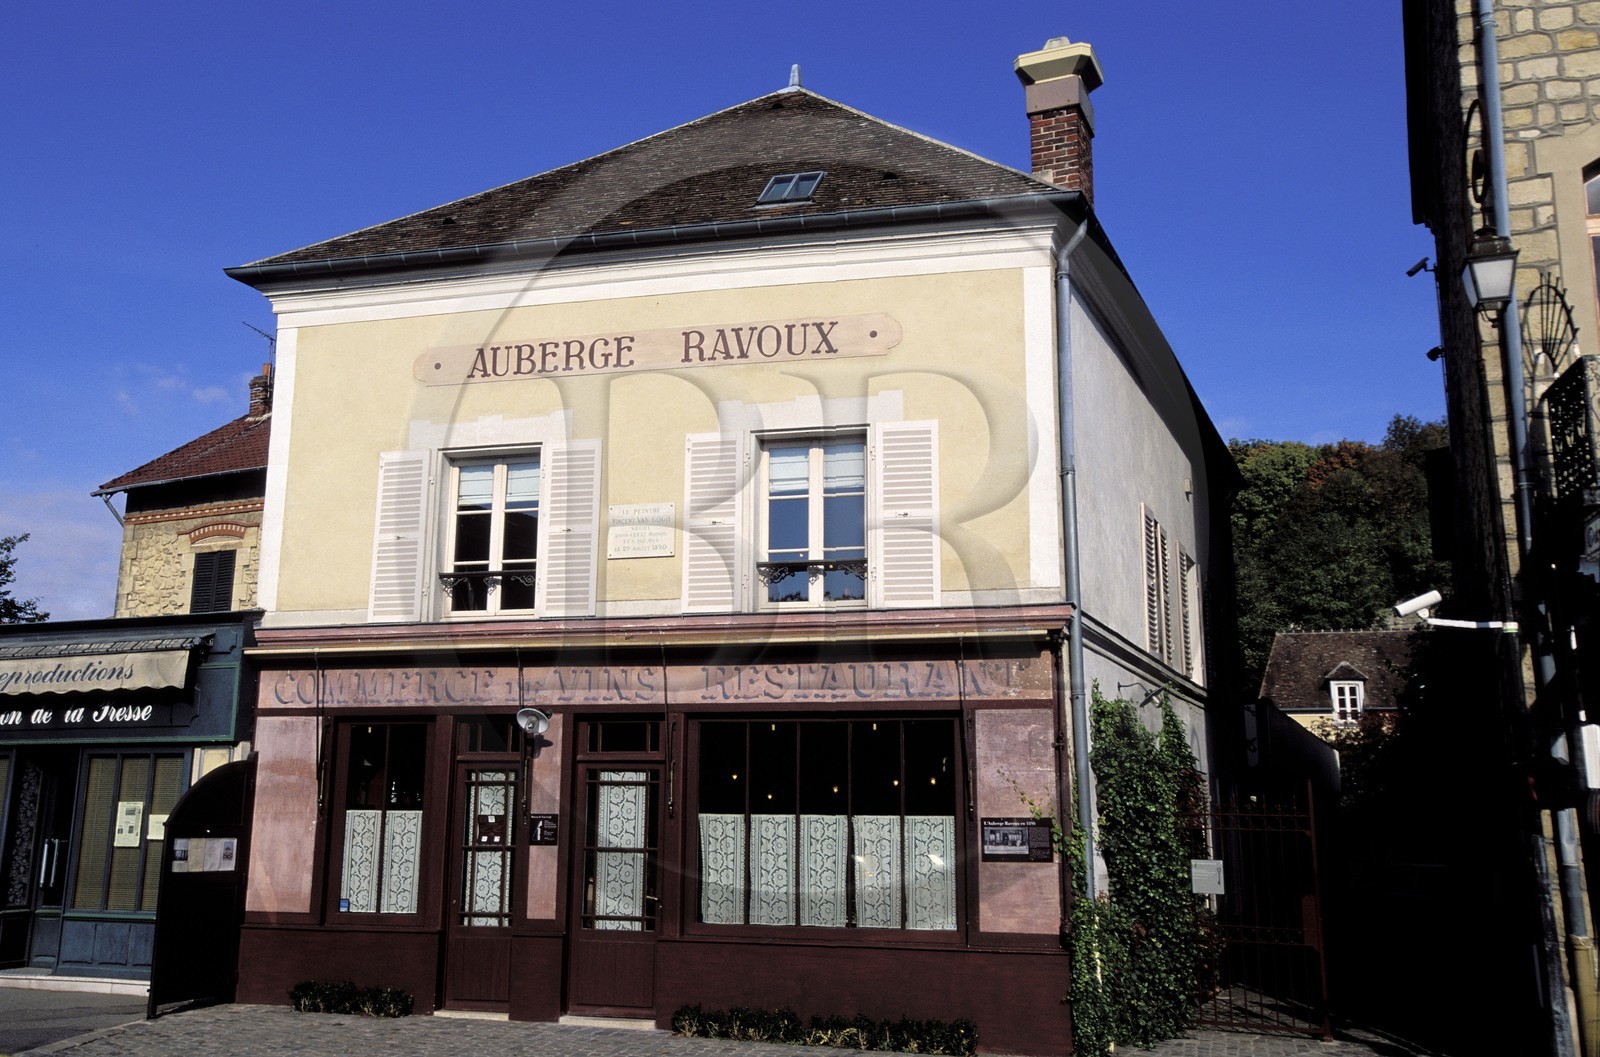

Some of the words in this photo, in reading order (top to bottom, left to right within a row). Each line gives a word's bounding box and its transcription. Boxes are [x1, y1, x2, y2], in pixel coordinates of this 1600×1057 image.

[467, 336, 635, 379] AUBERGE
[681, 321, 839, 363] RAVOUX
[636, 516, 649, 524] VAN
[651, 515, 671, 524] GOGH
[652, 543, 667, 551] 1890
[275, 669, 496, 705] COMMERCE
[551, 666, 658, 703] VINS
[700, 660, 1028, 702] RESTAURANT
